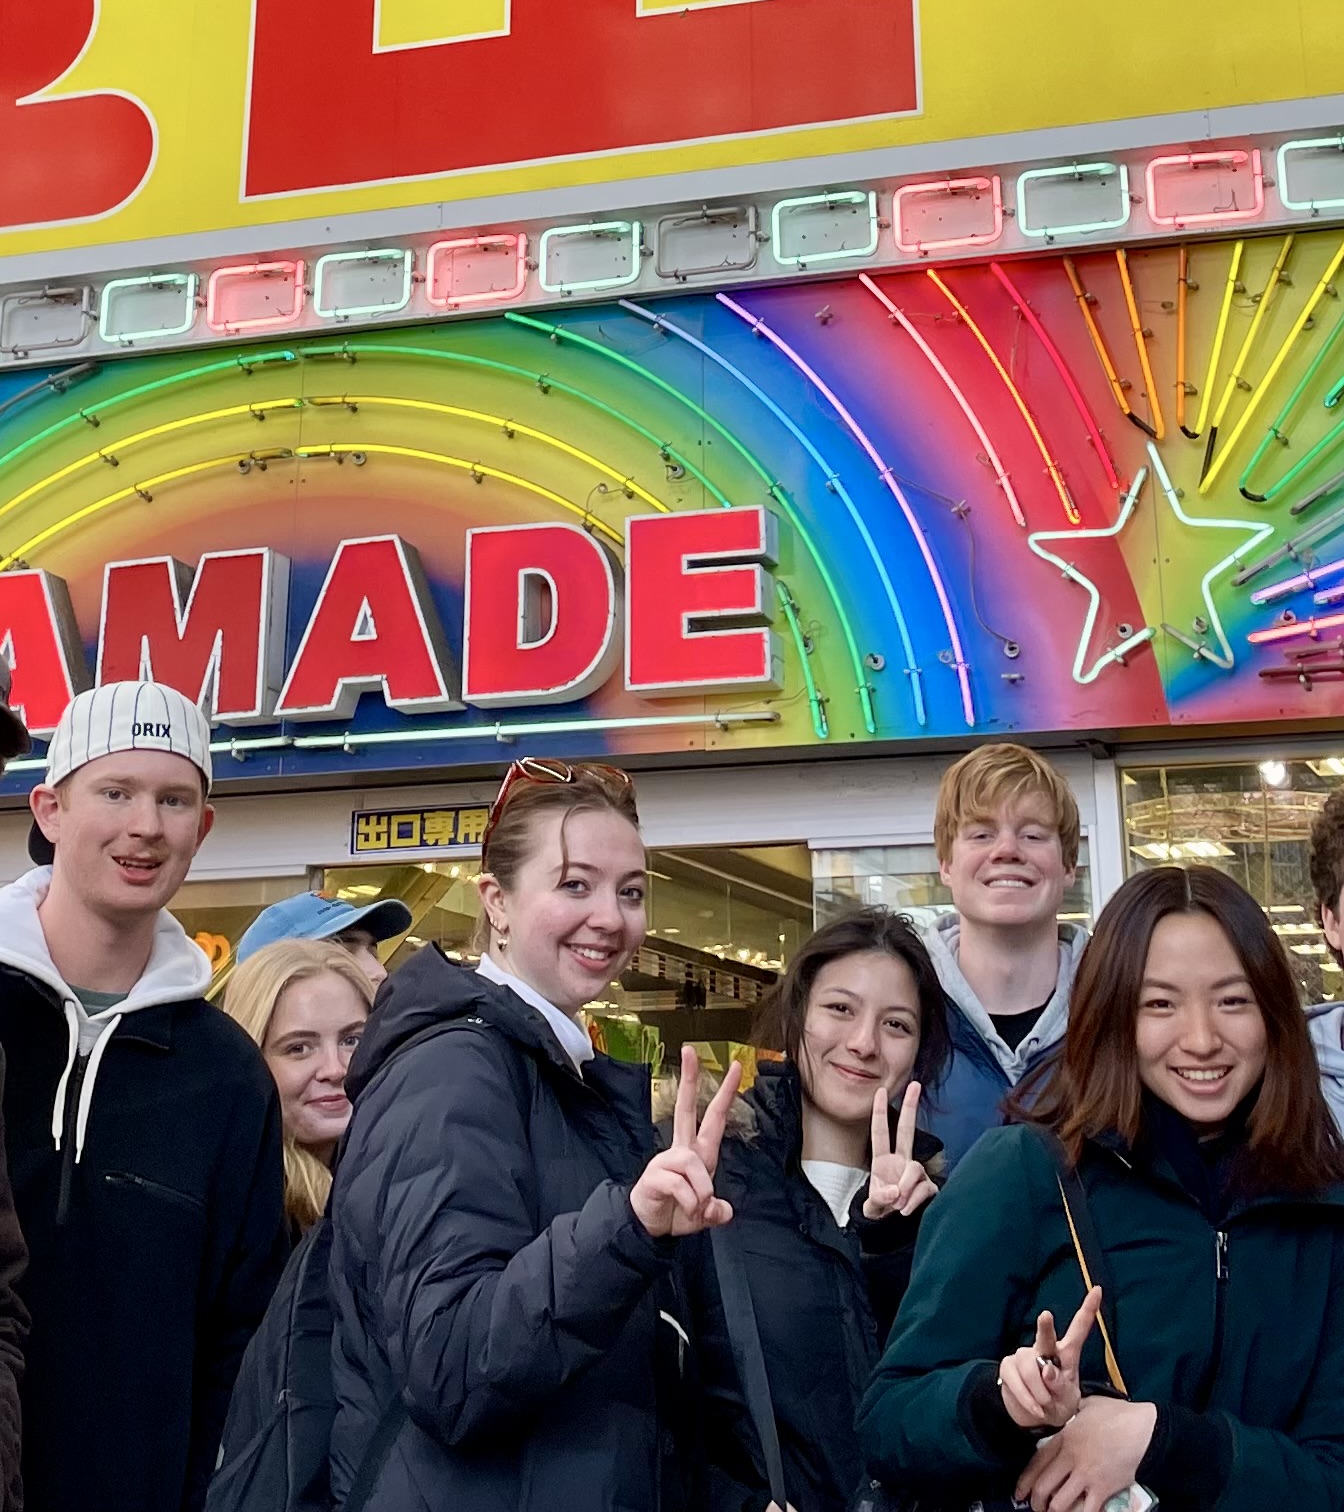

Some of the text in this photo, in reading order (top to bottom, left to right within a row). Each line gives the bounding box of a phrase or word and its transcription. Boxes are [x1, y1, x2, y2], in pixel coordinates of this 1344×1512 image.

[131, 722, 171, 738] ORIX
[356, 808, 489, 850] 出口専用
